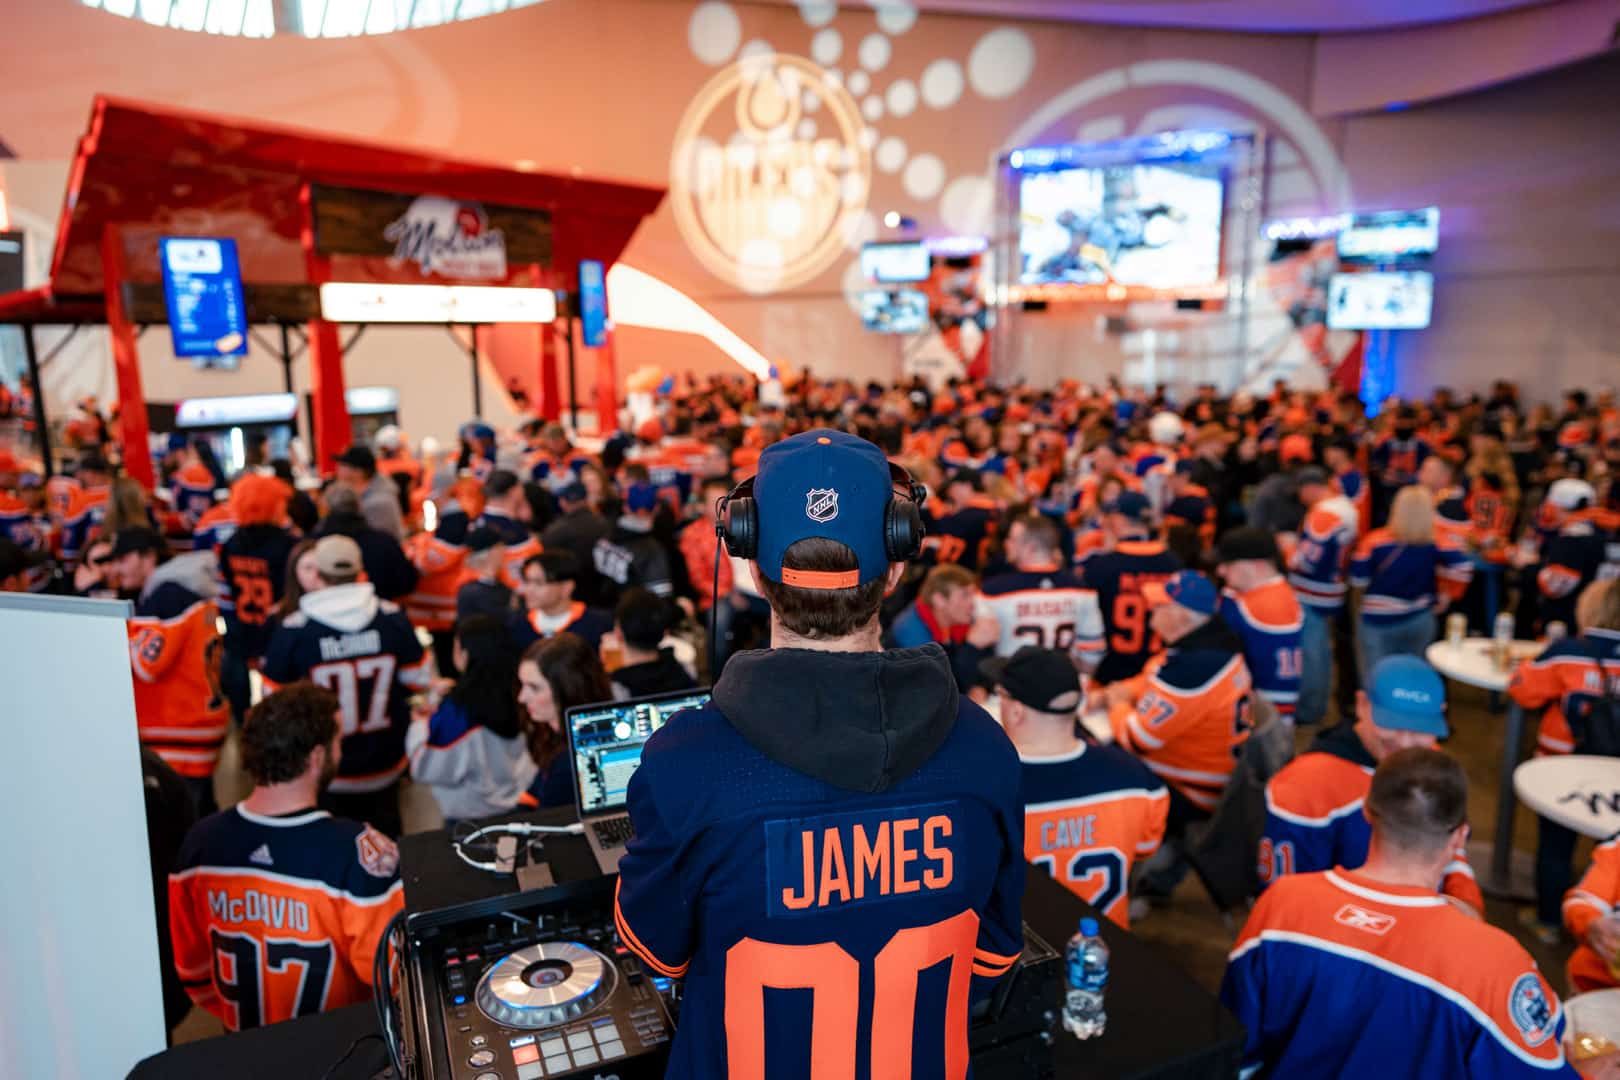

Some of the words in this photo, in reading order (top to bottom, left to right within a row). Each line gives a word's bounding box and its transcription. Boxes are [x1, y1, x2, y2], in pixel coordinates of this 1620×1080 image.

[813, 496, 833, 515] NHL
[782, 815, 954, 910] JAMES
[1041, 815, 1097, 851] CAVE
[208, 889, 311, 933] McDAVID
[208, 924, 337, 1032] 97
[723, 908, 981, 1080] 00
